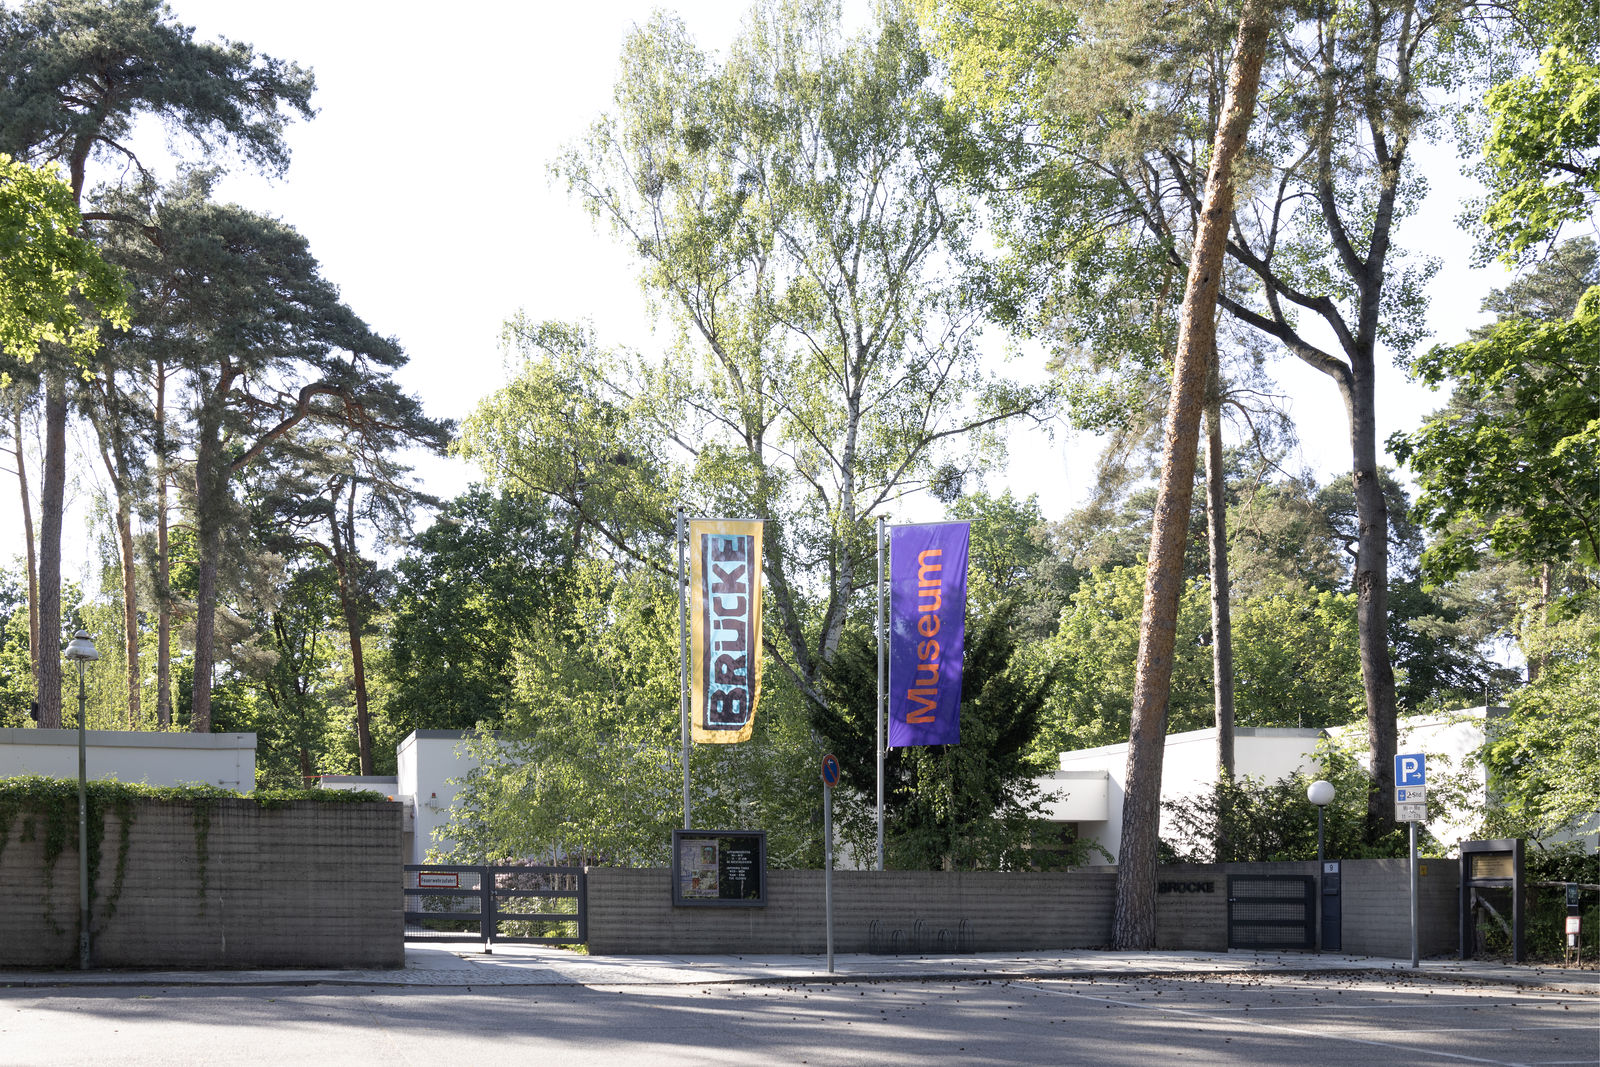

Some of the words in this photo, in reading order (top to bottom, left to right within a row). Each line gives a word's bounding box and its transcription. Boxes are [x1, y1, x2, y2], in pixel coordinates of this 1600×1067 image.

[709, 536, 747, 723] BRÜCKE
[906, 549, 942, 724] Museum
[1402, 758, 1418, 782] P
